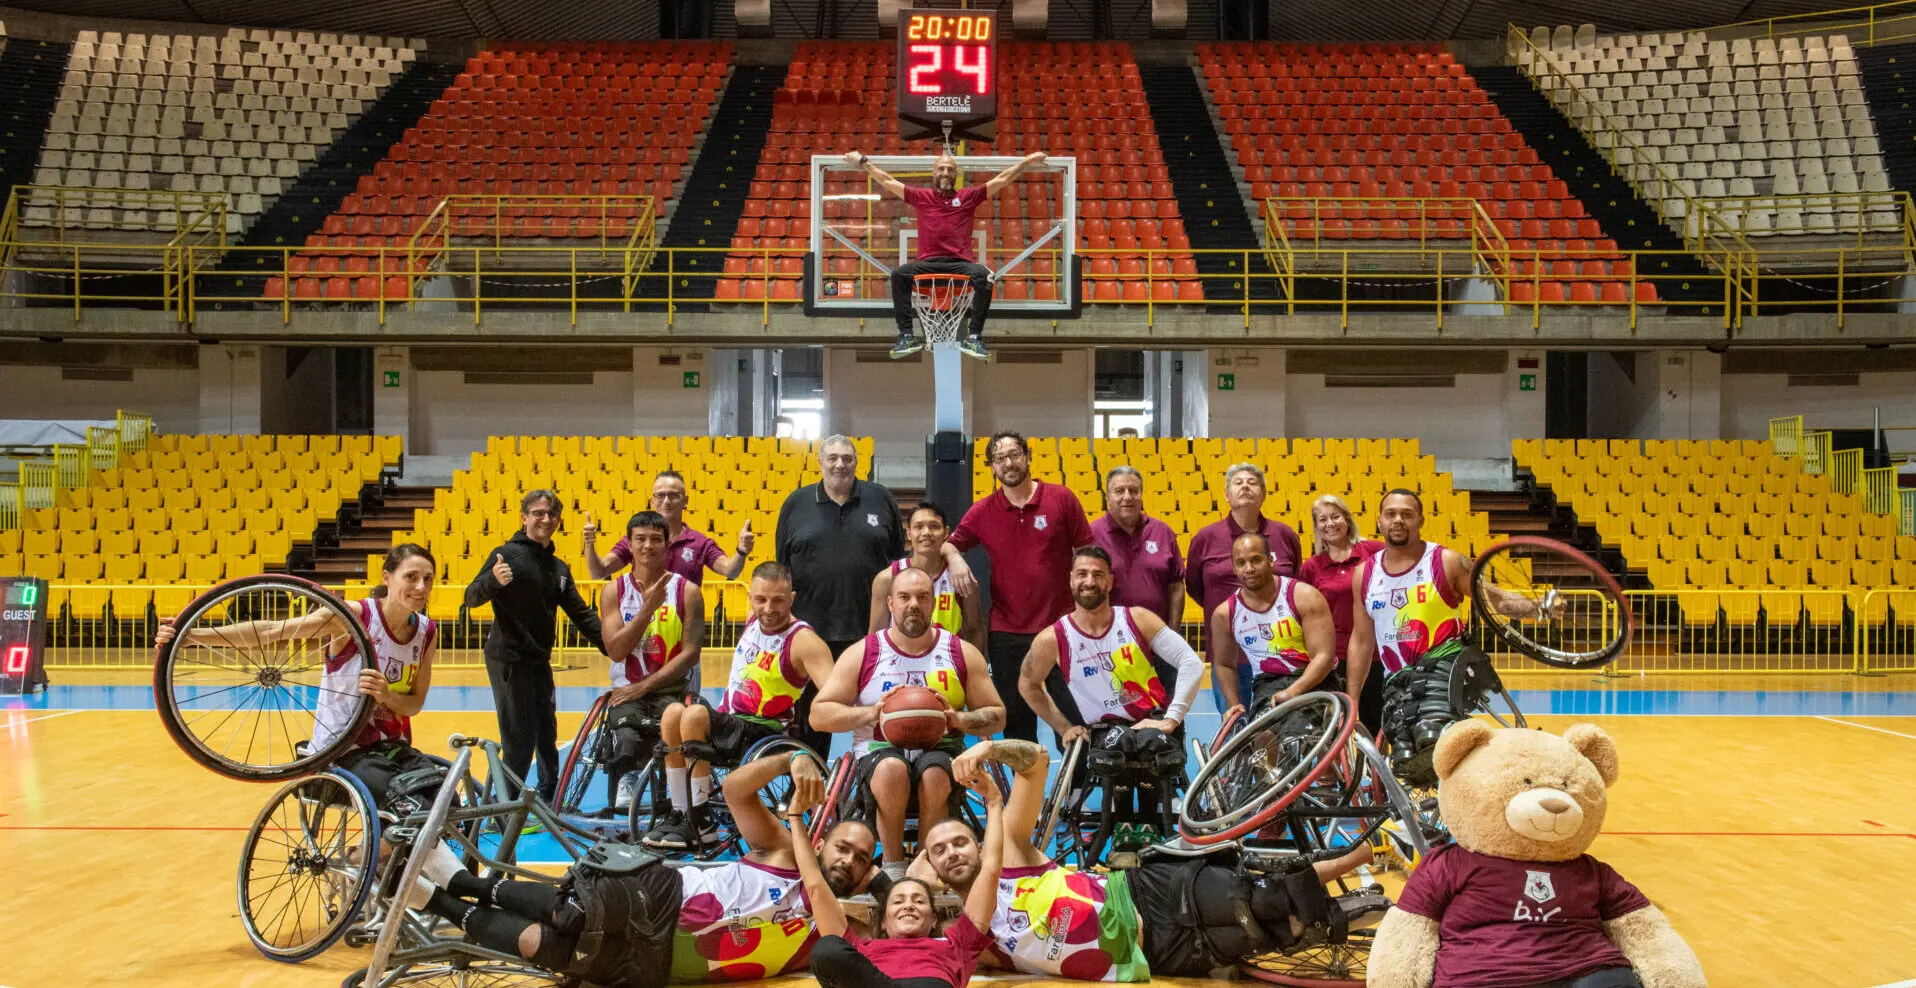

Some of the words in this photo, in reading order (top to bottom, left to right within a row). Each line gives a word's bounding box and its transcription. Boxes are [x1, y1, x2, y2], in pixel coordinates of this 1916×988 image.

[910, 16, 990, 40] 20:00
[910, 45, 986, 94] 24
[22, 586, 37, 605] 0
[939, 594, 951, 611] 21
[1416, 584, 1427, 604] 6
[3, 610, 36, 620] GUEST
[659, 606, 669, 622] 2
[1277, 619, 1293, 638] 17
[8, 647, 29, 672] 0
[1121, 646, 1134, 665] 4
[937, 670, 948, 690] 9
